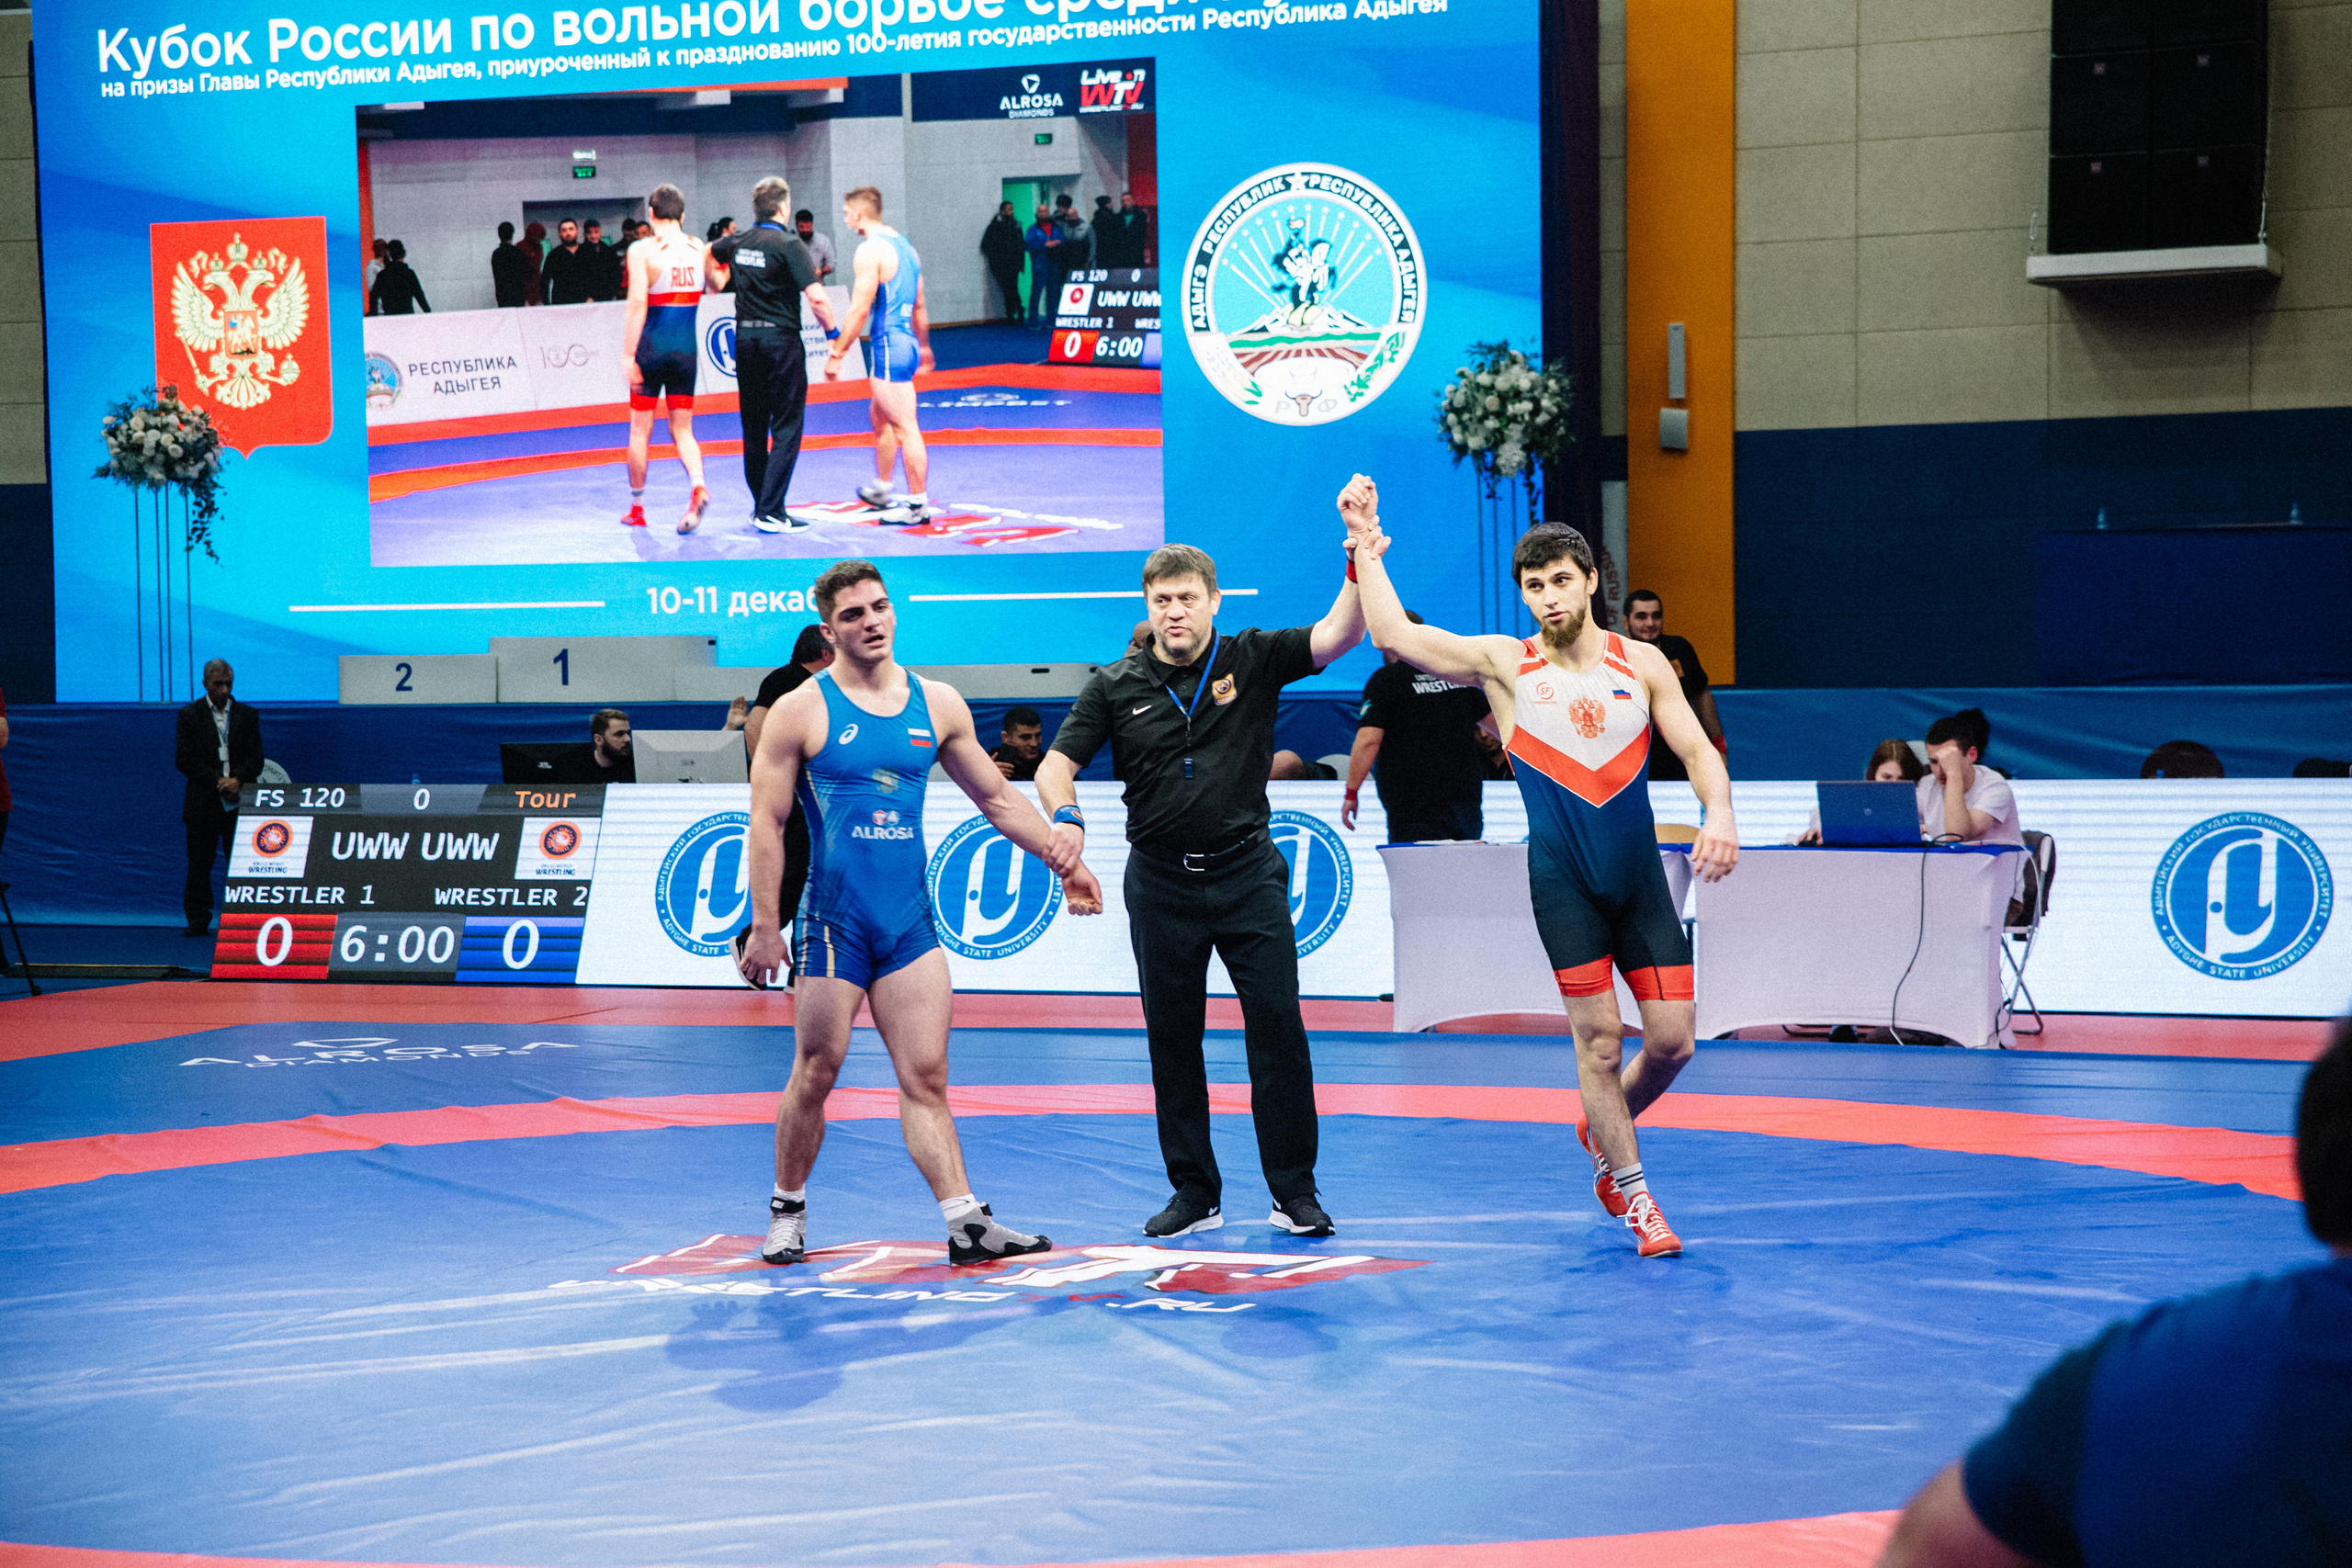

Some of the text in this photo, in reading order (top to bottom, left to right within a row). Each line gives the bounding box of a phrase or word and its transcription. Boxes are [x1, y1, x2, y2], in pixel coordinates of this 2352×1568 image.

[97, 23, 253, 79] Кубок
[268, 18, 452, 62] России
[471, 13, 535, 51] по
[553, 0, 780, 46] вольной
[101, 82, 125, 97] на
[130, 76, 194, 98] призы
[199, 73, 259, 93] Главы
[266, 65, 390, 90] Республики
[396, 59, 482, 84] Адыгея,
[488, 47, 650, 79] приуроченный
[656, 50, 671, 67] к
[675, 37, 841, 68] празднованию
[845, 28, 962, 55] 100-летия
[967, 14, 1195, 48] государственности
[1202, 1, 1347, 30] Республика
[1353, 0, 1448, 20] Адыгея
[1000, 93, 1064, 110] ALROSA
[1009, 107, 1055, 118] DIAMONDS
[1201, 176, 1286, 254] РЕСПУБЛИК
[1309, 174, 1418, 323] РЕСПУБЛИКА АДЫГЕЯ
[671, 266, 695, 288] RUS
[1071, 268, 1141, 283] FS 120 0
[1097, 290, 1131, 308] UWW
[1055, 316, 1161, 330] WRESTLER 1 WRES
[1064, 331, 1144, 358] 0 6:00
[408, 355, 517, 378] РЕСПУБЛИКА
[434, 376, 502, 396] АДЫГЕЯ
[646, 585, 820, 617] 10-11 декаб
[395, 662, 413, 692] 2
[553, 649, 570, 687] 1
[1540, 686, 1552, 695] SF
[254, 787, 577, 810] FS 120 0 Tour
[851, 826, 914, 840] ALROSA
[331, 831, 501, 862] UWW UWW
[225, 886, 588, 907] WRESTLER 1 WRESTLER 2
[255, 916, 540, 970] 0 6:00 0
[692, 942, 720, 955] STATE
[963, 947, 992, 958] STATE
[997, 919, 1048, 957] UNIVERSITY
[1296, 922, 1335, 956] IVERSITY
[2165, 934, 2315, 979] ADYGHE STATE UNIVERSITY
[178, 1041, 581, 1066] ALROSA
[245, 1049, 532, 1068] DIAMONDS
